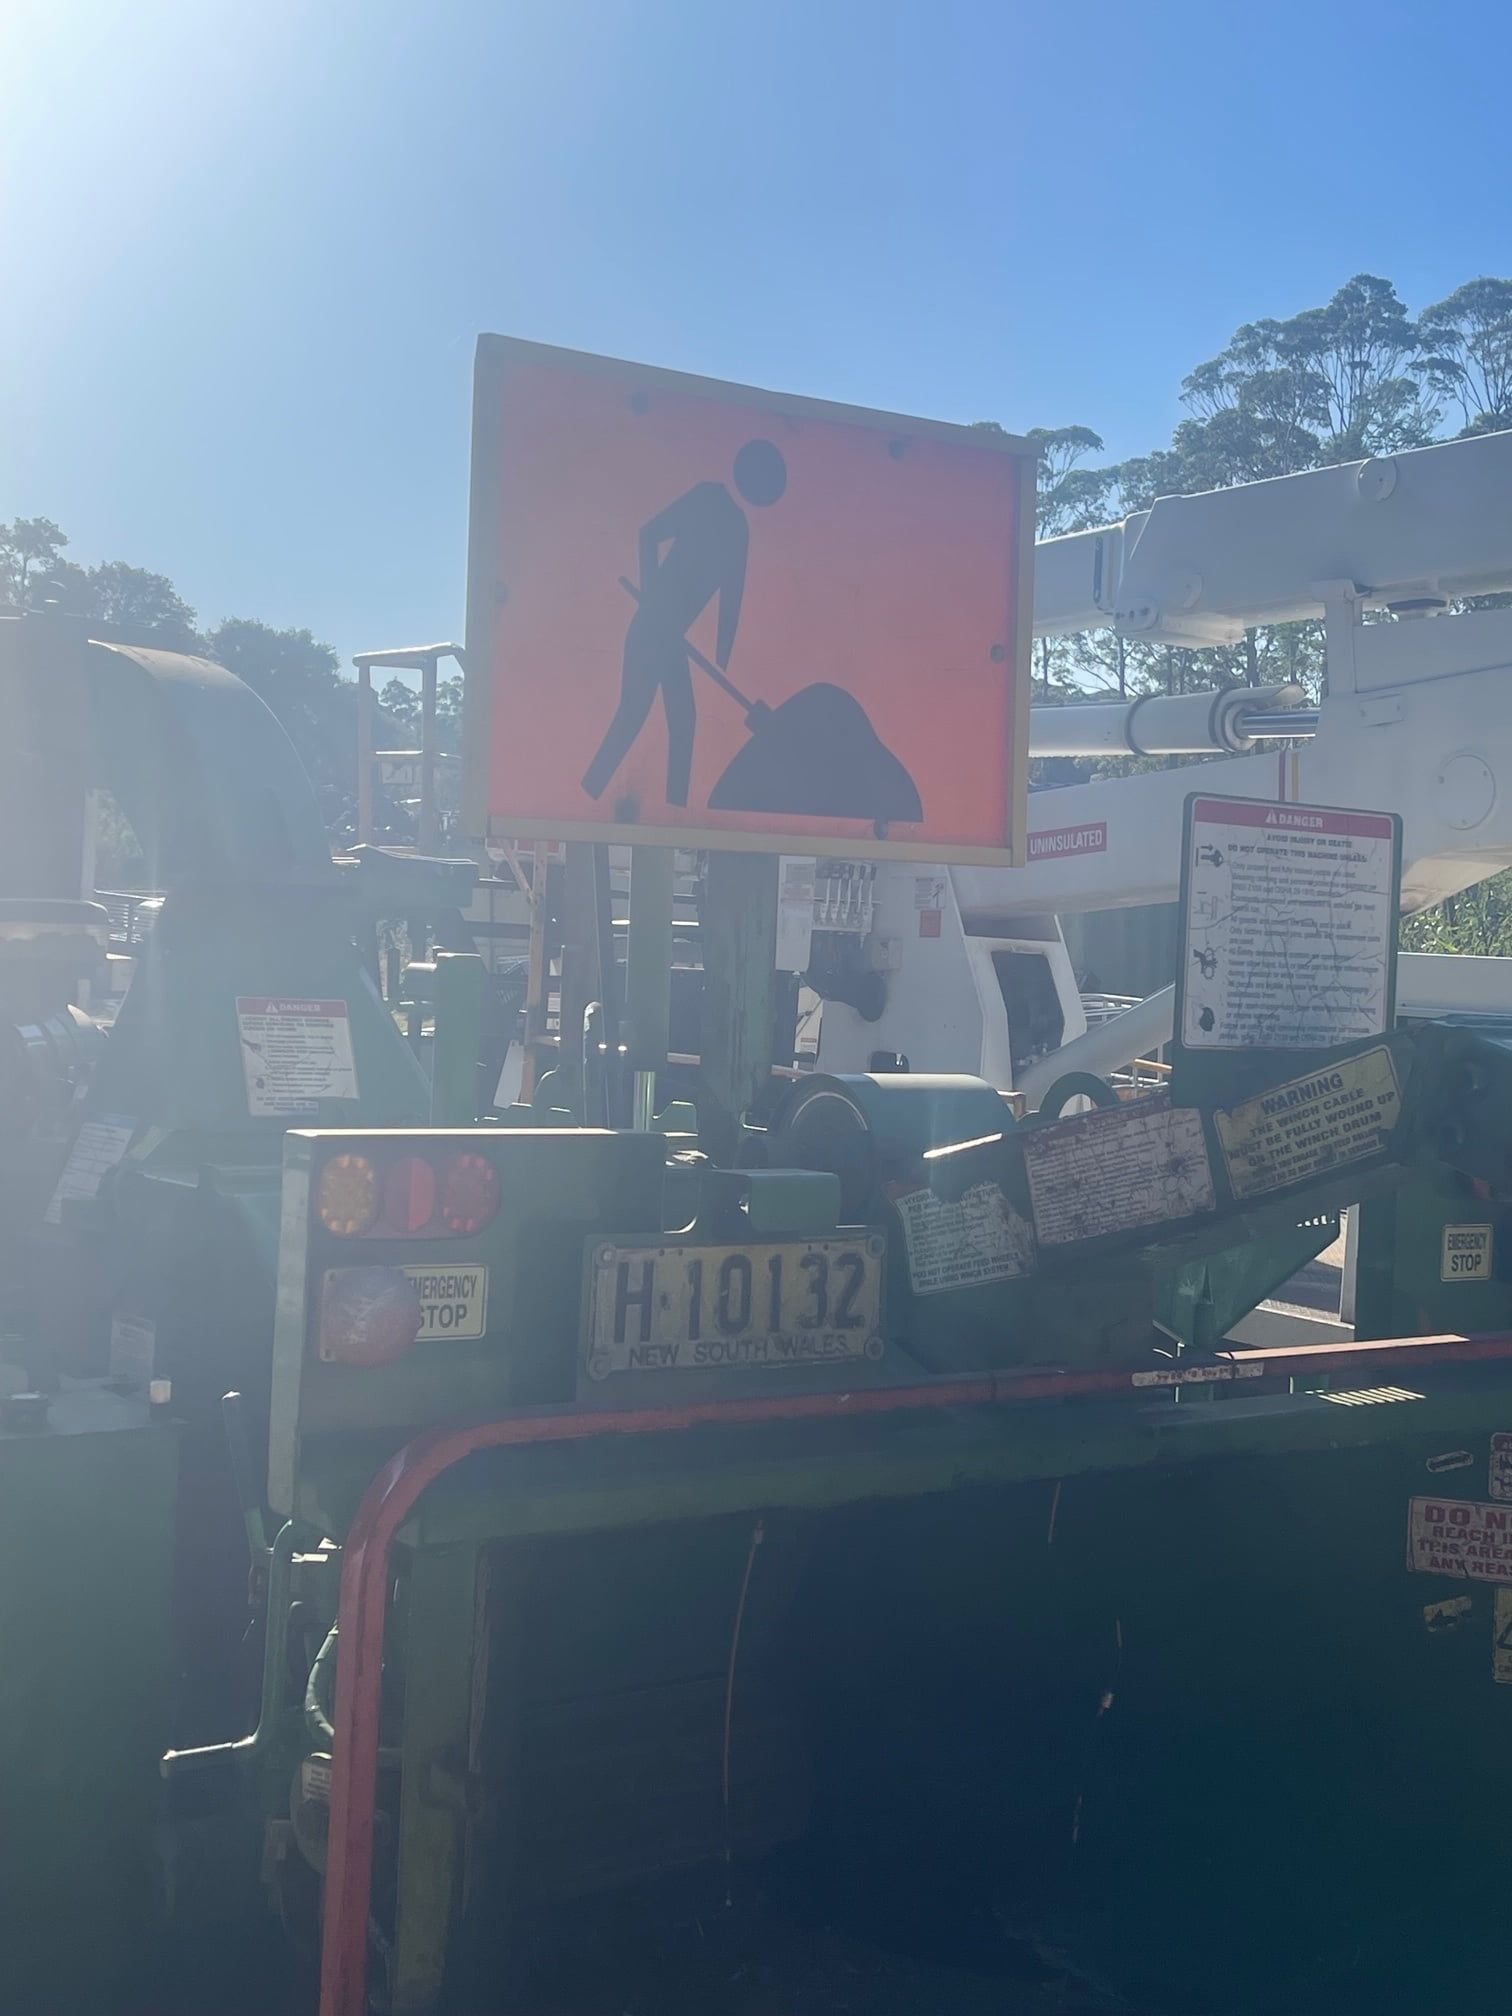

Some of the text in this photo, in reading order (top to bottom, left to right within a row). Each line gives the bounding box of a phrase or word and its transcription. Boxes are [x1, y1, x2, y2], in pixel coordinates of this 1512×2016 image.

[1279, 814, 1324, 828] DANGER
[1030, 830, 1103, 855] UNINSULATED
[1261, 1073, 1343, 1115] WARNING
[1251, 1088, 1365, 1138] THE WINCH CABLE
[1266, 1131, 1282, 1146] BE
[1286, 1117, 1321, 1140] FULLY
[1325, 1099, 1374, 1123] WOUND
[1377, 1091, 1396, 1105] UP
[1269, 1144, 1291, 1161] THE
[1295, 1127, 1339, 1149] WINCH
[1343, 1111, 1382, 1133] DRUM
[1451, 1254, 1481, 1272] STOP
[629, 1334, 848, 1368] NEW SOUTH WALES
[1425, 1504, 1471, 1526] DO
[1433, 1525, 1495, 1544] REACH
[1430, 1556, 1466, 1570] ANY
